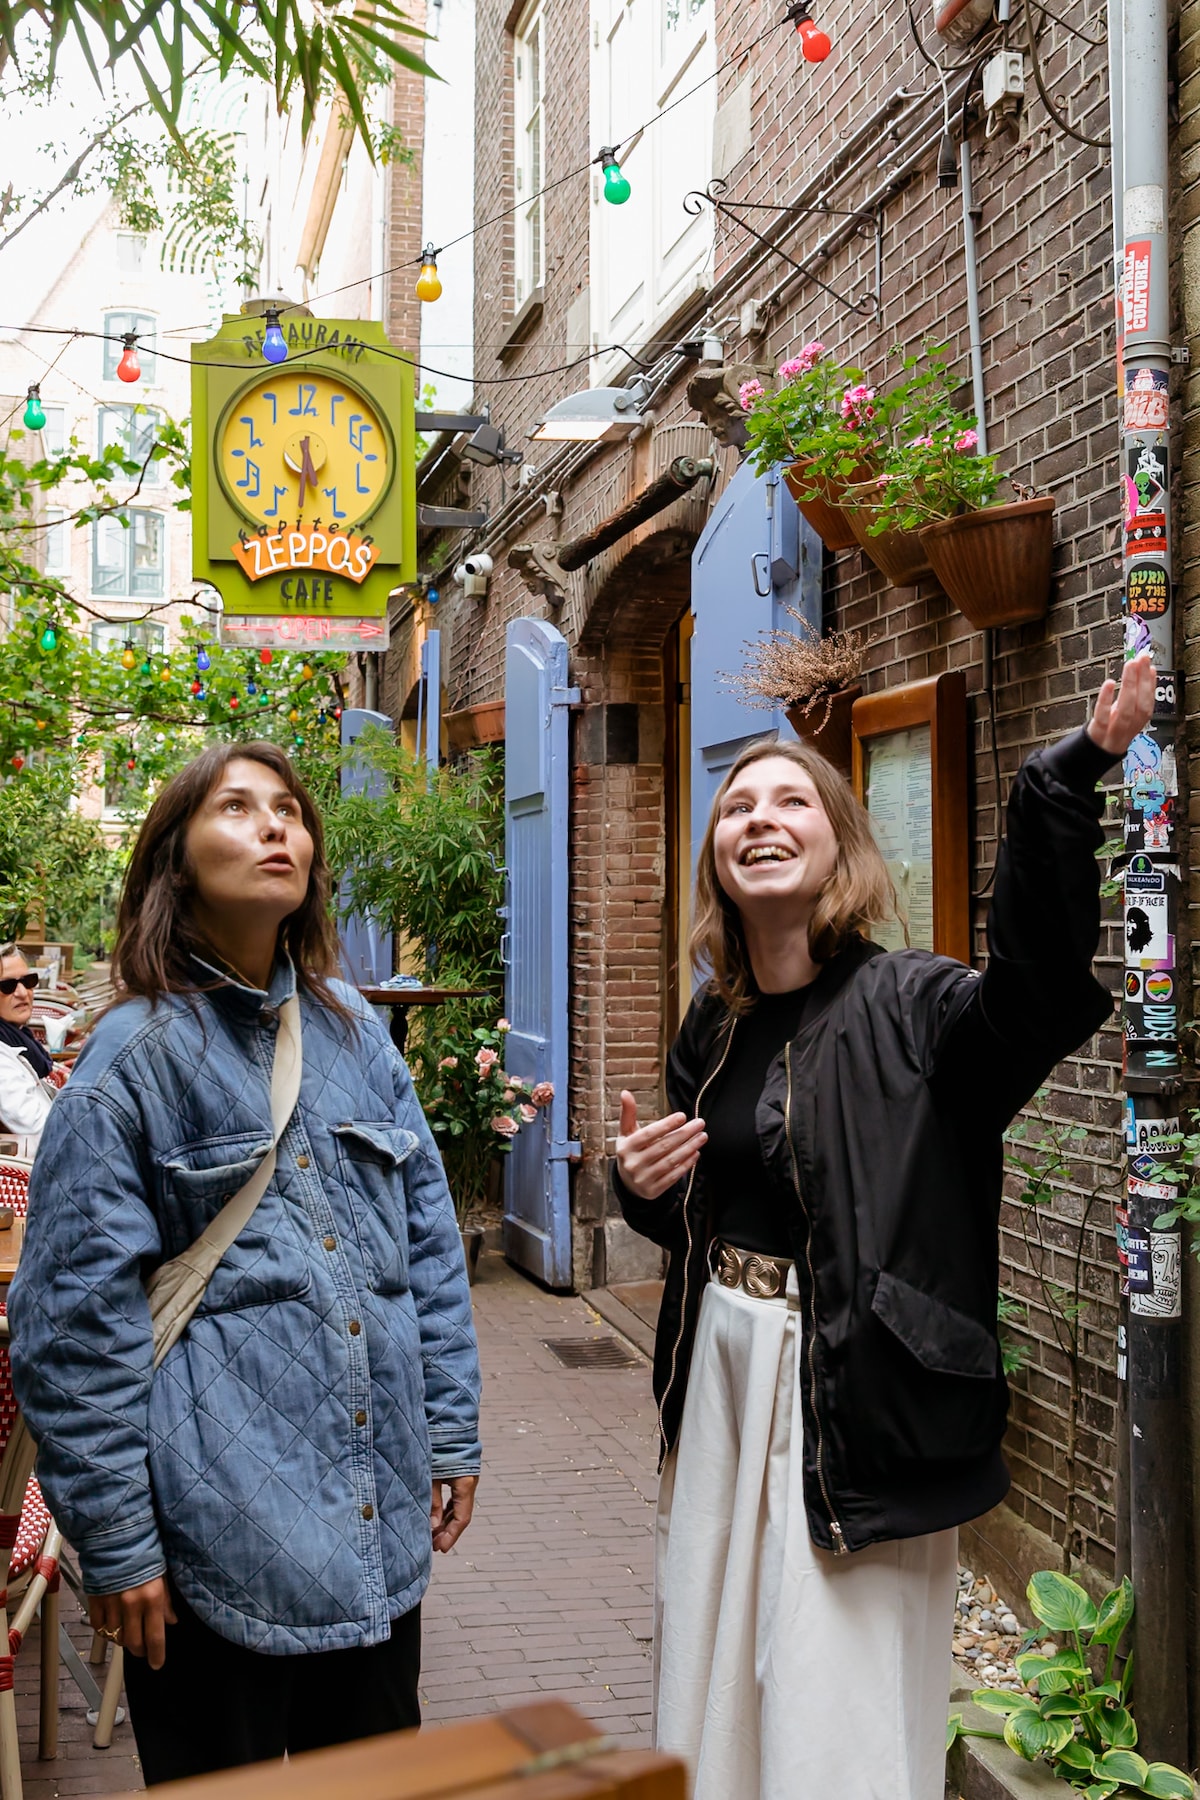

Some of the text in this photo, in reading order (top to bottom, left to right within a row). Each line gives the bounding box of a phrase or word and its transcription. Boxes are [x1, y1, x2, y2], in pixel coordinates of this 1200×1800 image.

[1133, 254, 1149, 330] CULTURE.
[242, 322, 369, 360] REAURANT
[244, 533, 372, 578] ZEPPOS
[280, 577, 334, 601] CAFE
[1130, 570, 1166, 586] BURN
[1129, 585, 1167, 598] UP THE
[1130, 597, 1166, 613] BASS
[278, 616, 331, 640] OPEN
[1143, 1004, 1178, 1067] DIDSN
